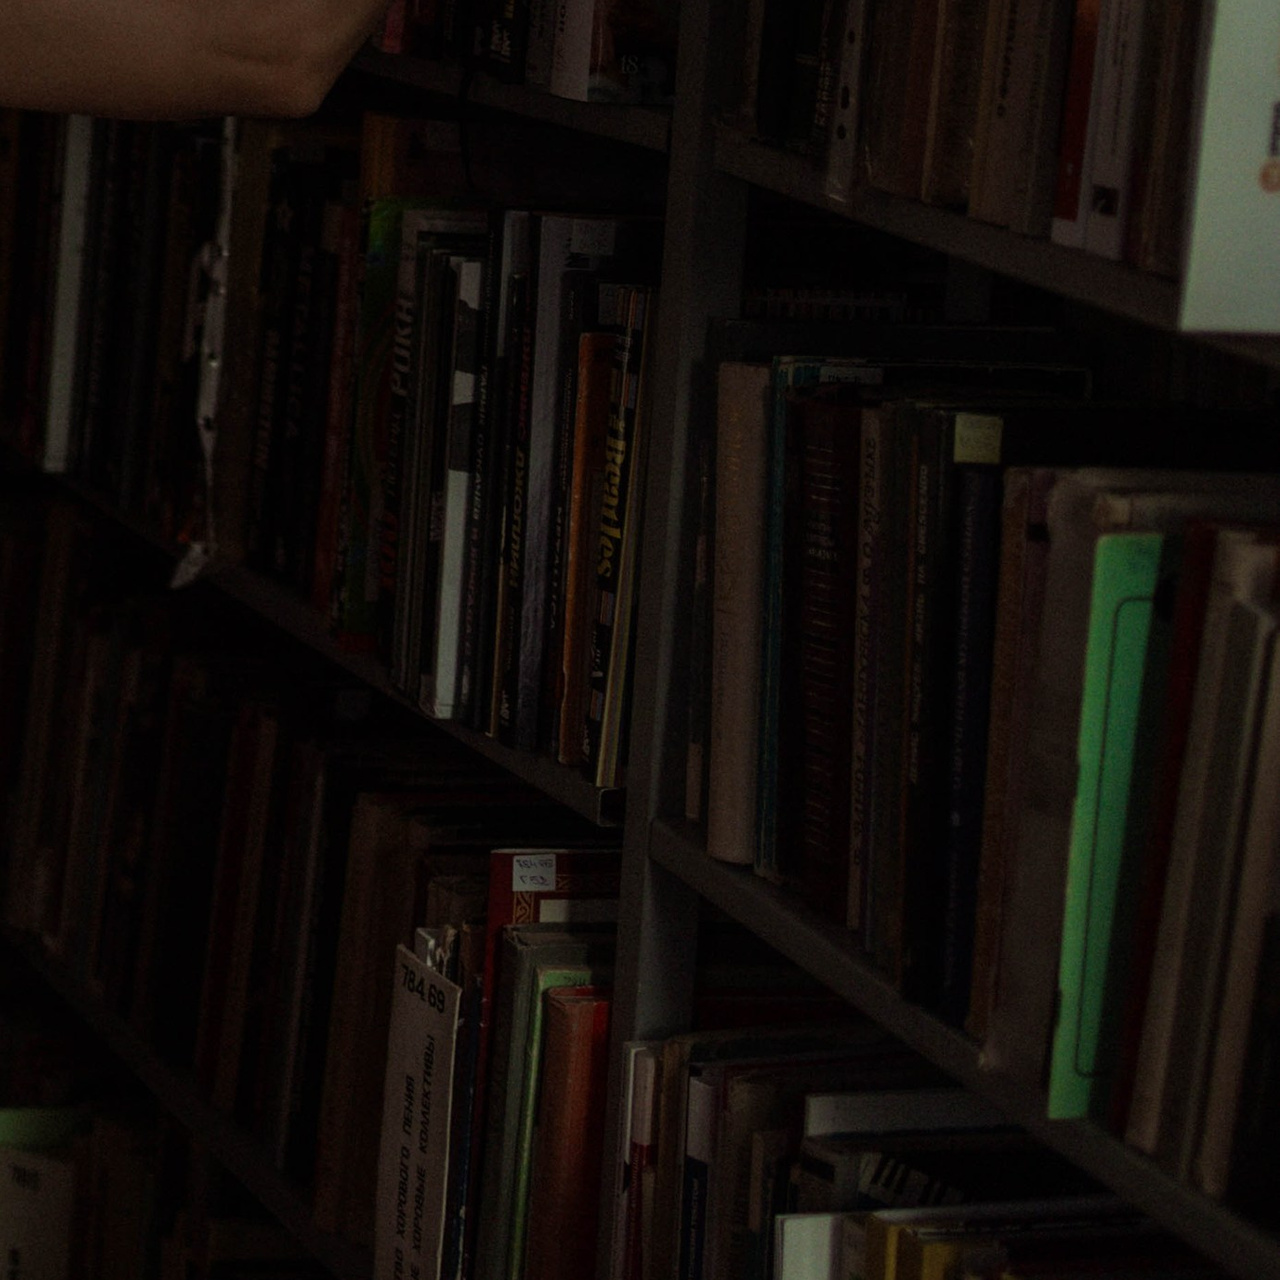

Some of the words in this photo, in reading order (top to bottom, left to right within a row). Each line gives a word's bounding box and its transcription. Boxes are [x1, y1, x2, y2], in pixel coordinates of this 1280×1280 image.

[596, 434, 628, 579] Beatles
[401, 1073, 415, 1137] ПЕНИЯ
[418, 1033, 436, 1155] КОЛЛЕКТИВЫ
[395, 1145, 411, 1239] ХОРОВОГО
[410, 1164, 427, 1253] ХОРОВЫЕ
